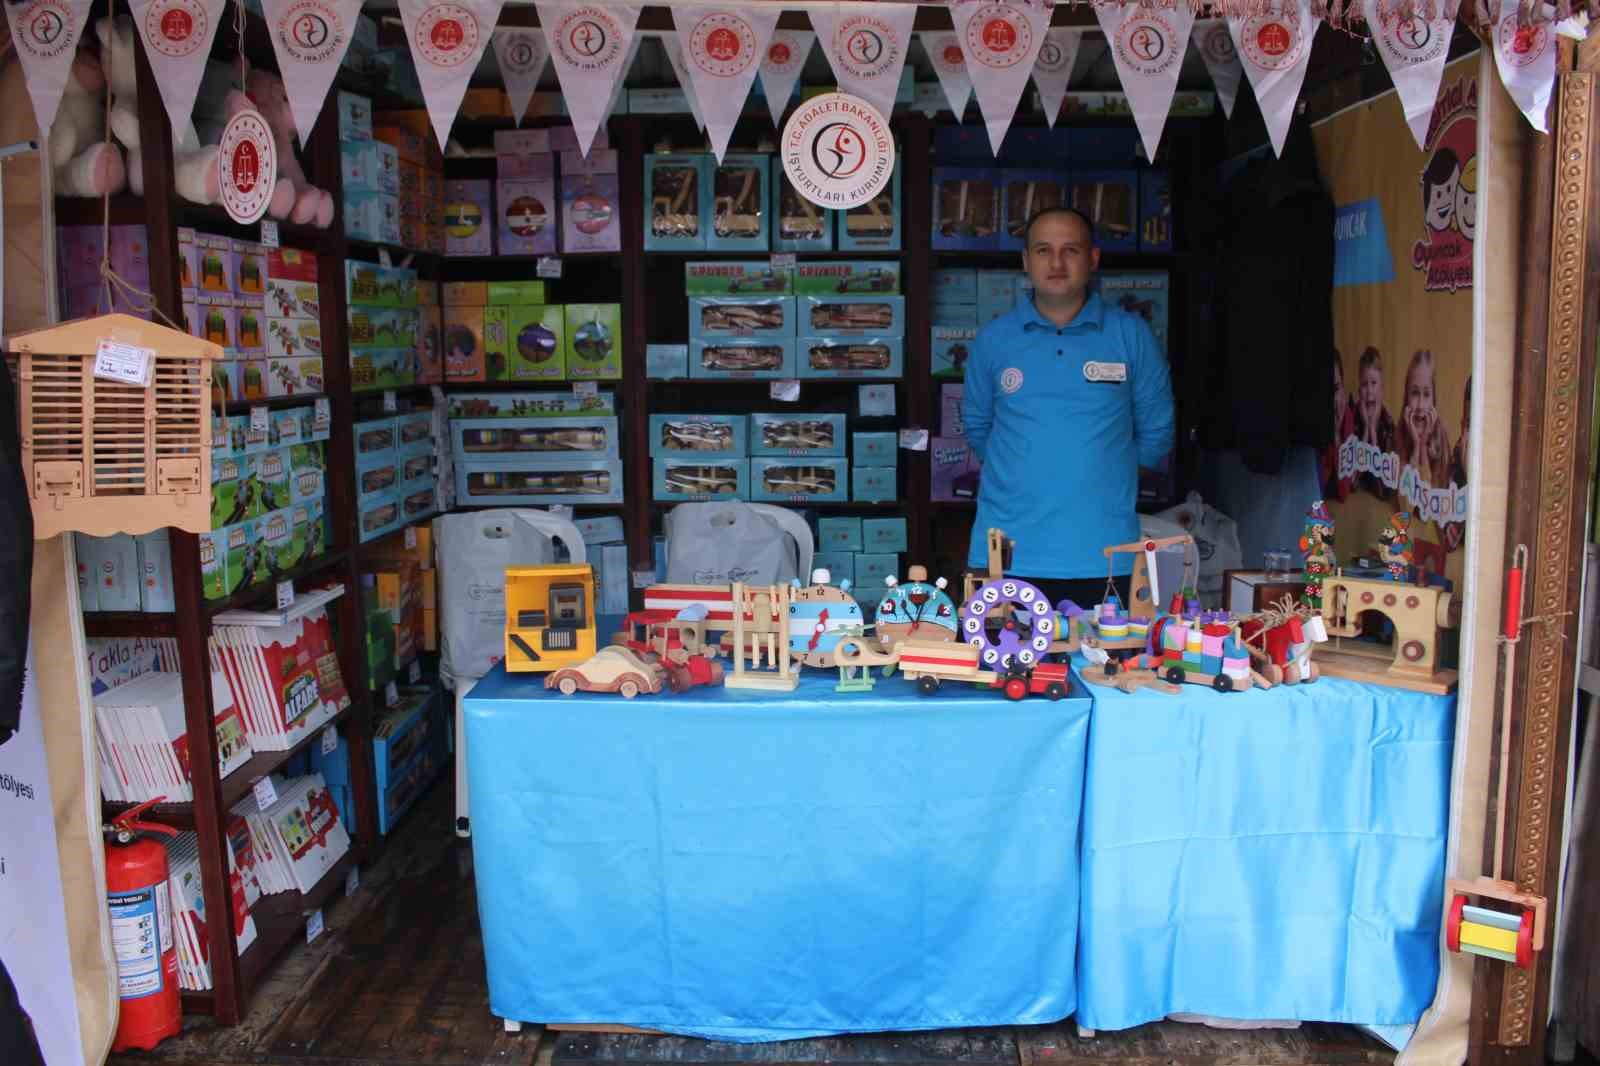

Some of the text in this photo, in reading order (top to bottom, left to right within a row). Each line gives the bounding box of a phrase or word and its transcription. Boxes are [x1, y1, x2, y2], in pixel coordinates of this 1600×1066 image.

[800, 102, 839, 129] ADALET
[841, 102, 888, 153] BAKANLIĞI
[789, 152, 888, 202] İŞYURTLARI KURUMU
[816, 588, 825, 596] 12
[849, 605, 857, 613] 2
[973, 603, 983, 612] 10
[1036, 602, 1046, 612] 2
[969, 621, 976, 630] 9
[1041, 621, 1049, 631] 3
[987, 652, 995, 661] 7
[1022, 653, 1031, 662] 5
